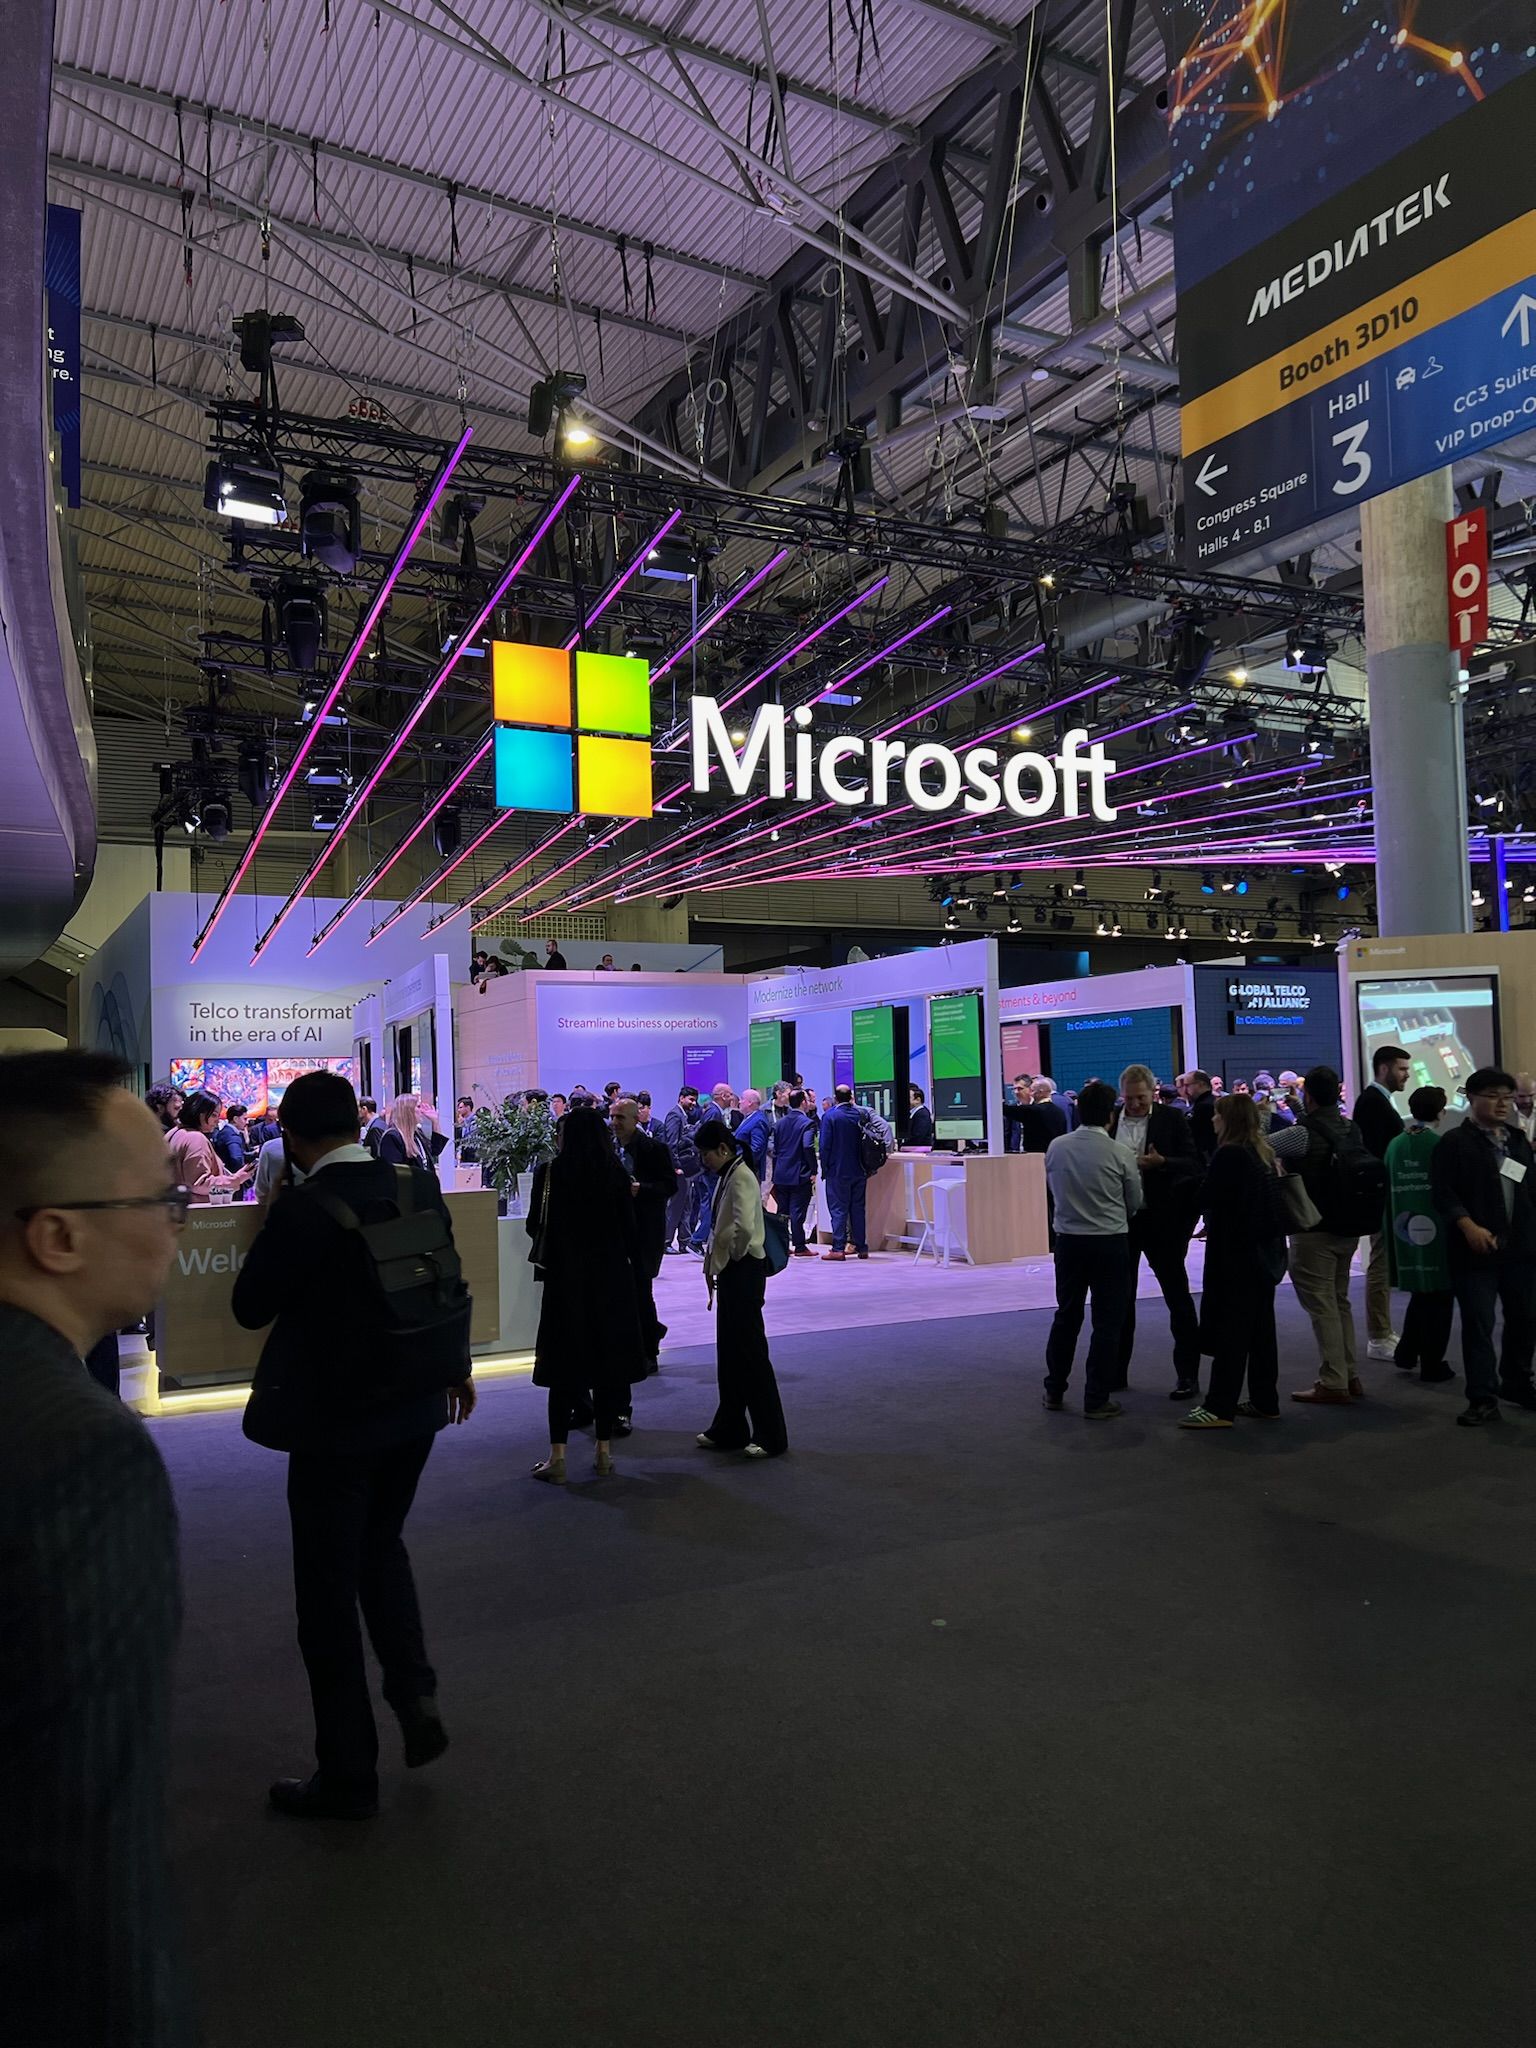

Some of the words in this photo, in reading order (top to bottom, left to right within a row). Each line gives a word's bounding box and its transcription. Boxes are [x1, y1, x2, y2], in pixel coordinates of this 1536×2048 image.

[1247, 172, 1451, 326] MEDIATEK
[1280, 337, 1350, 391] Booth
[1356, 296, 1419, 350] 3D10
[1329, 380, 1371, 419] Hall
[1454, 385, 1489, 413] CC3
[1436, 429, 1465, 453] VIP
[1332, 419, 1371, 495] 3
[1197, 497, 1256, 531] Congress
[1260, 473, 1308, 503] Square
[1198, 537, 1229, 559] Halls
[1232, 528, 1241, 543] 4
[1254, 515, 1271, 534] 8.1
[690, 695, 1118, 822] Microsoft
[754, 986, 793, 1004] Modernize
[794, 983, 808, 997] the
[809, 977, 843, 996] network
[1033, 993, 1039, 1006] &
[1042, 988, 1077, 1006] beyond
[1229, 985, 1274, 996] GLOBAL
[1274, 985, 1306, 996] TELCO
[189, 1002, 239, 1019] Telco
[243, 1003, 352, 1019] transformat
[1263, 998, 1310, 1008] ALLIANCE
[558, 1017, 615, 1029] Streamline
[617, 1018, 662, 1029] business
[664, 1017, 718, 1031] operations
[1066, 1022, 1074, 1031] In
[1074, 1019, 1119, 1030] Collaboration
[1244, 1016, 1292, 1024] Collaboration
[190, 1026, 206, 1042] in
[211, 1026, 242, 1042] the
[247, 1030, 276, 1042] era
[281, 1026, 301, 1042] of
[304, 1026, 322, 1042] AI
[193, 1219, 237, 1230] Microsoft
